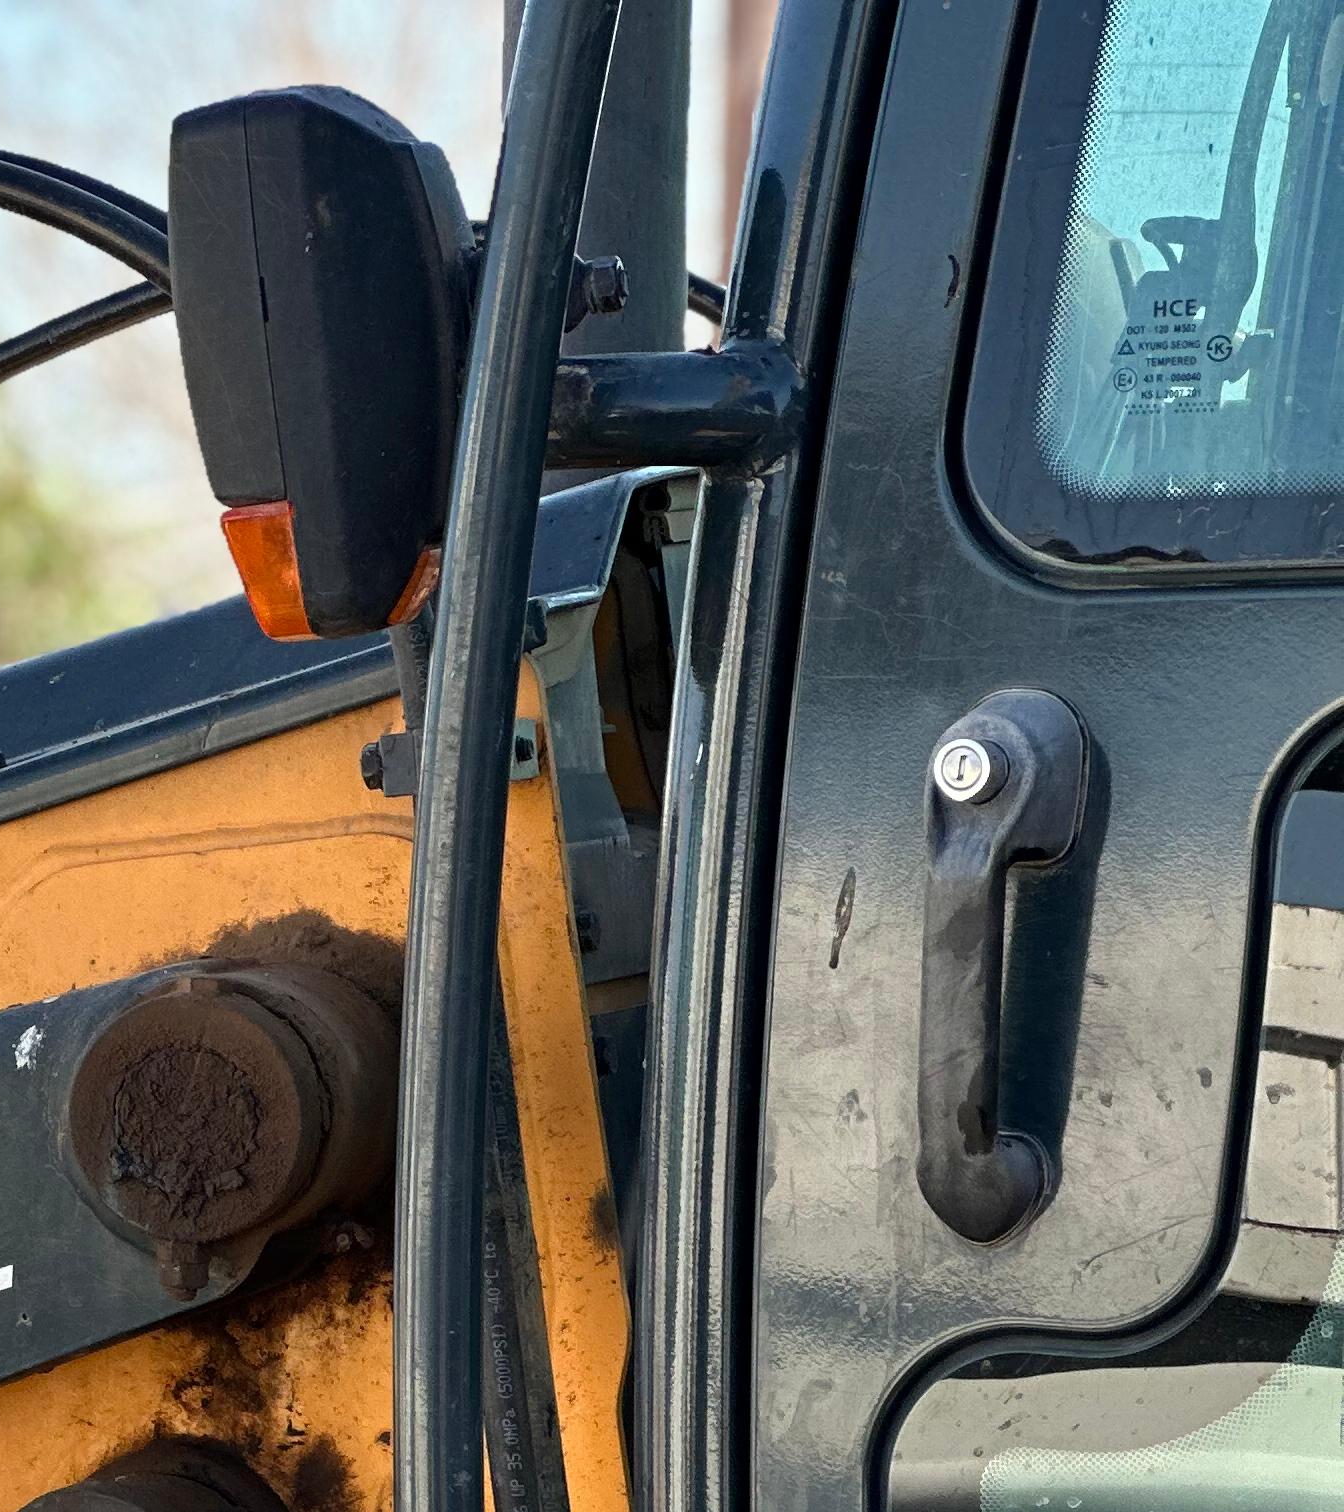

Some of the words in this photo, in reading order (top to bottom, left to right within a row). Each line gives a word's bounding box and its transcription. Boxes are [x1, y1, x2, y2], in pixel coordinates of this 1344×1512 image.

[1153, 299, 1197, 318] HCE
[1126, 326, 1145, 335] DOT
[1145, 356, 1197, 367] TEMPERED
[493, 1325, 512, 1400] (5000PSI)
[502, 1408, 524, 1472] 35.0MPa
